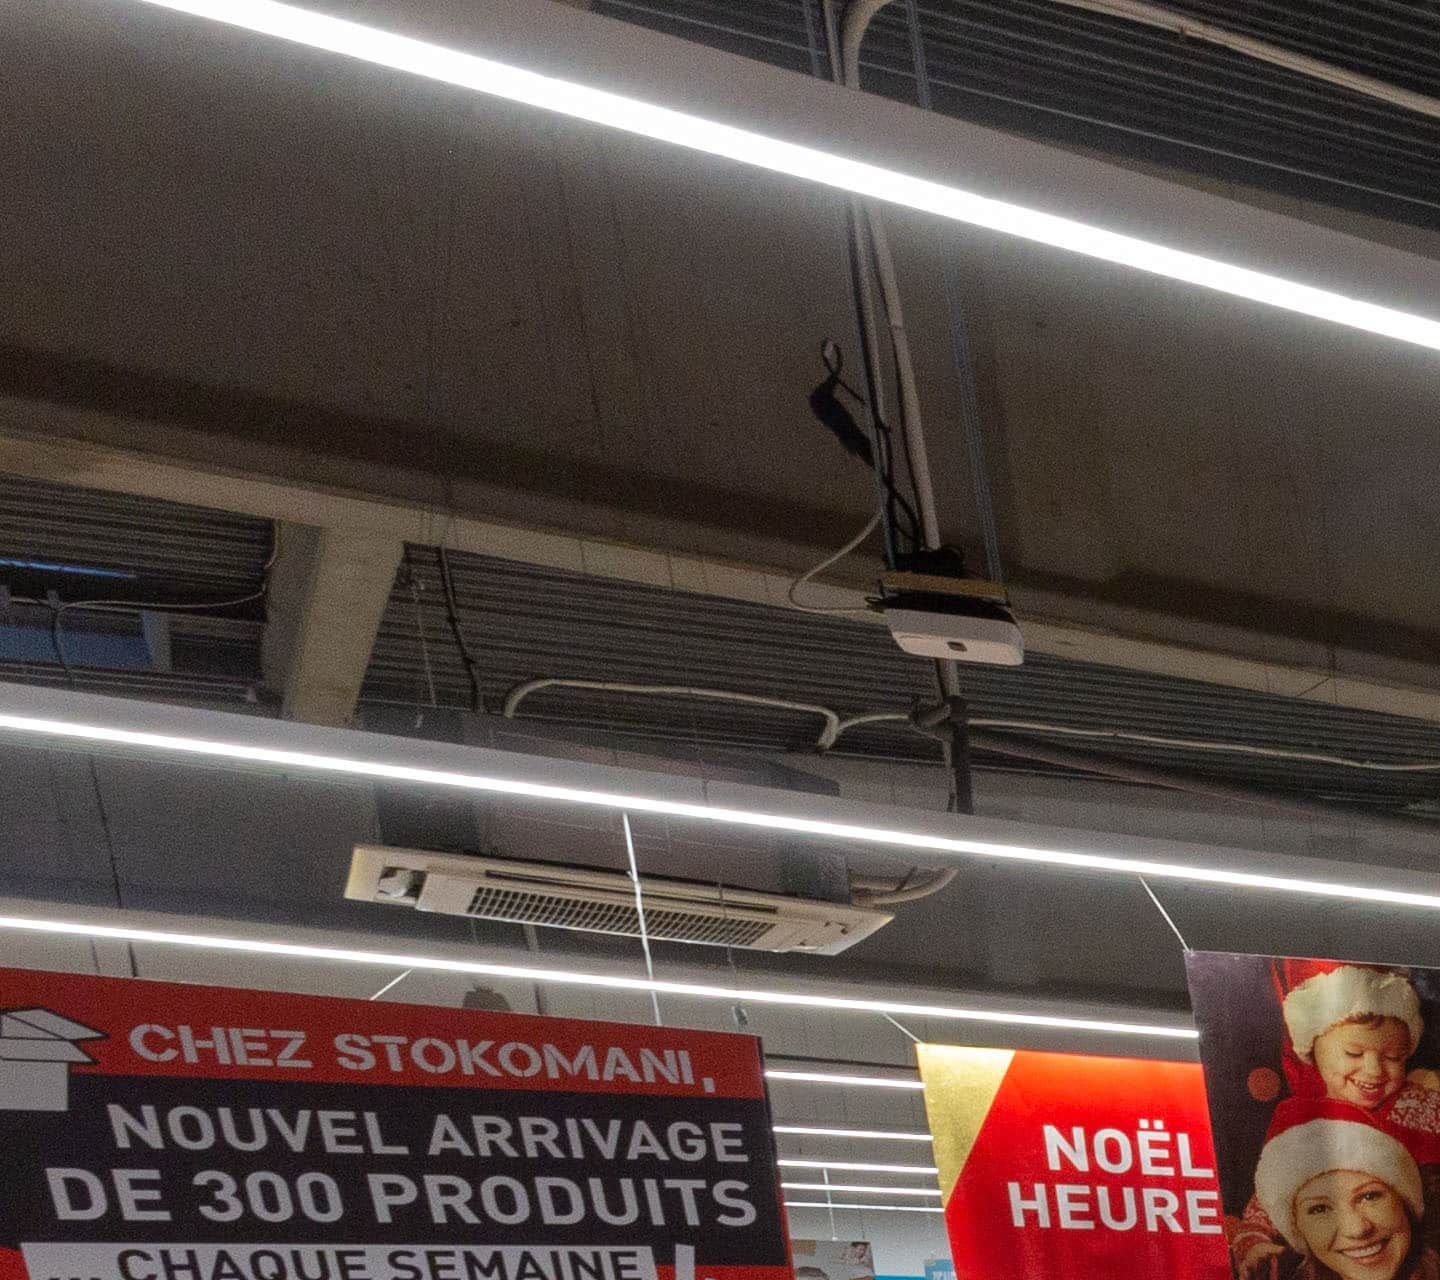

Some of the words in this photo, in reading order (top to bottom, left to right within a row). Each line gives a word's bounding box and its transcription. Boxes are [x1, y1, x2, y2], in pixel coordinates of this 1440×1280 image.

[130, 1025, 313, 1070] CHEZ
[337, 1034, 717, 1093] STOKOMANI,
[107, 1104, 409, 1156] NOUVEL
[427, 1113, 750, 1163] ARRIVAGE
[1043, 1119, 1215, 1180] NOËL
[45, 1166, 183, 1222] DE
[199, 1171, 345, 1224] 300
[374, 1173, 758, 1228] PRODUITS
[1007, 1181, 1224, 1236] HEURE
